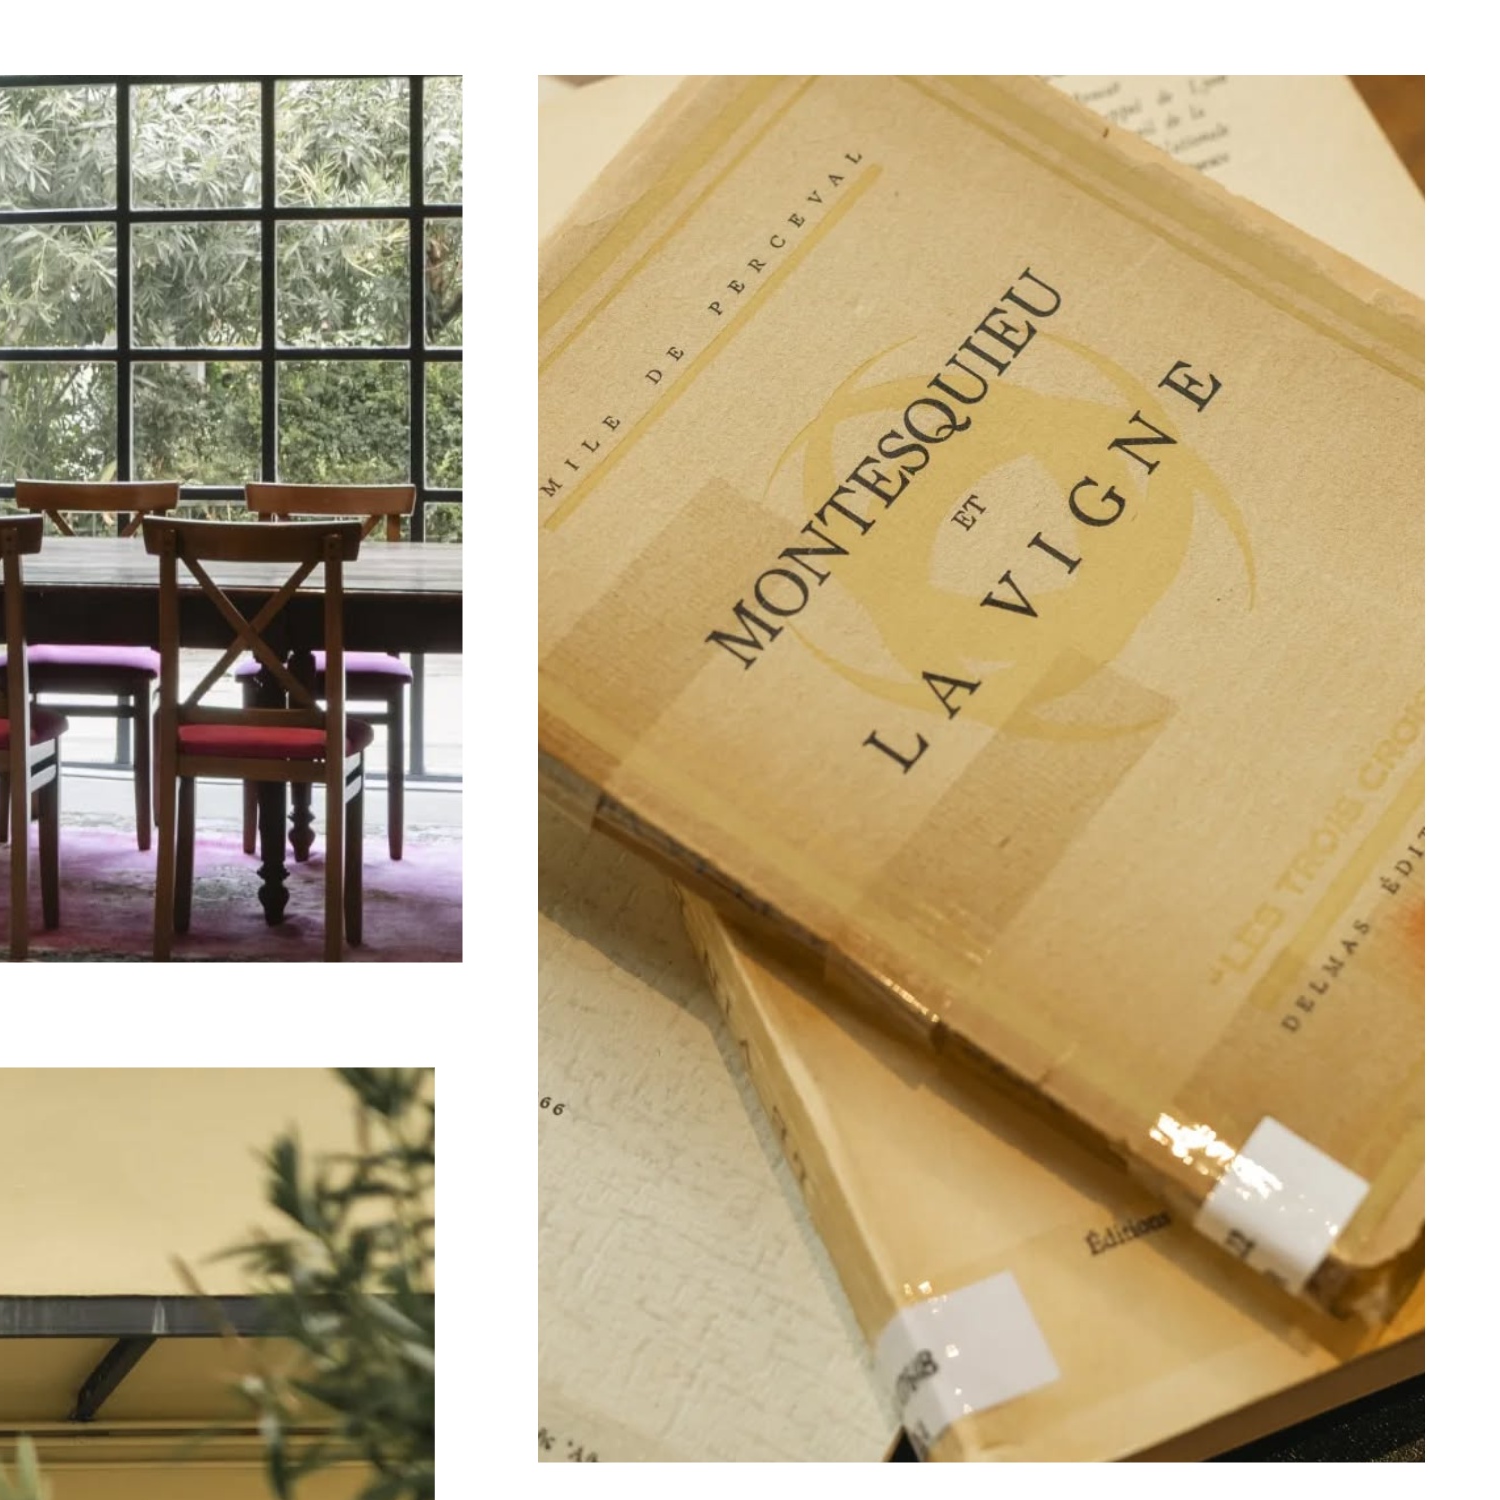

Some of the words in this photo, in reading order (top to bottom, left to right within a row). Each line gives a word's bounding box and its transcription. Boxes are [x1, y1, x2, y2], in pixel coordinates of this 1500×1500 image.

[539, 415, 621, 498] MILE
[644, 346, 684, 385] DE
[707, 150, 863, 316] PERCEVAL
[704, 267, 1062, 670] MONTESQUIEU
[950, 494, 988, 532] ET
[862, 670, 982, 774] LA
[979, 360, 1223, 620] VIGNE
[1274, 794, 1365, 895] TROIS
[1280, 919, 1371, 1034] DELMAS
[1084, 1210, 1172, 1257] Éditions
